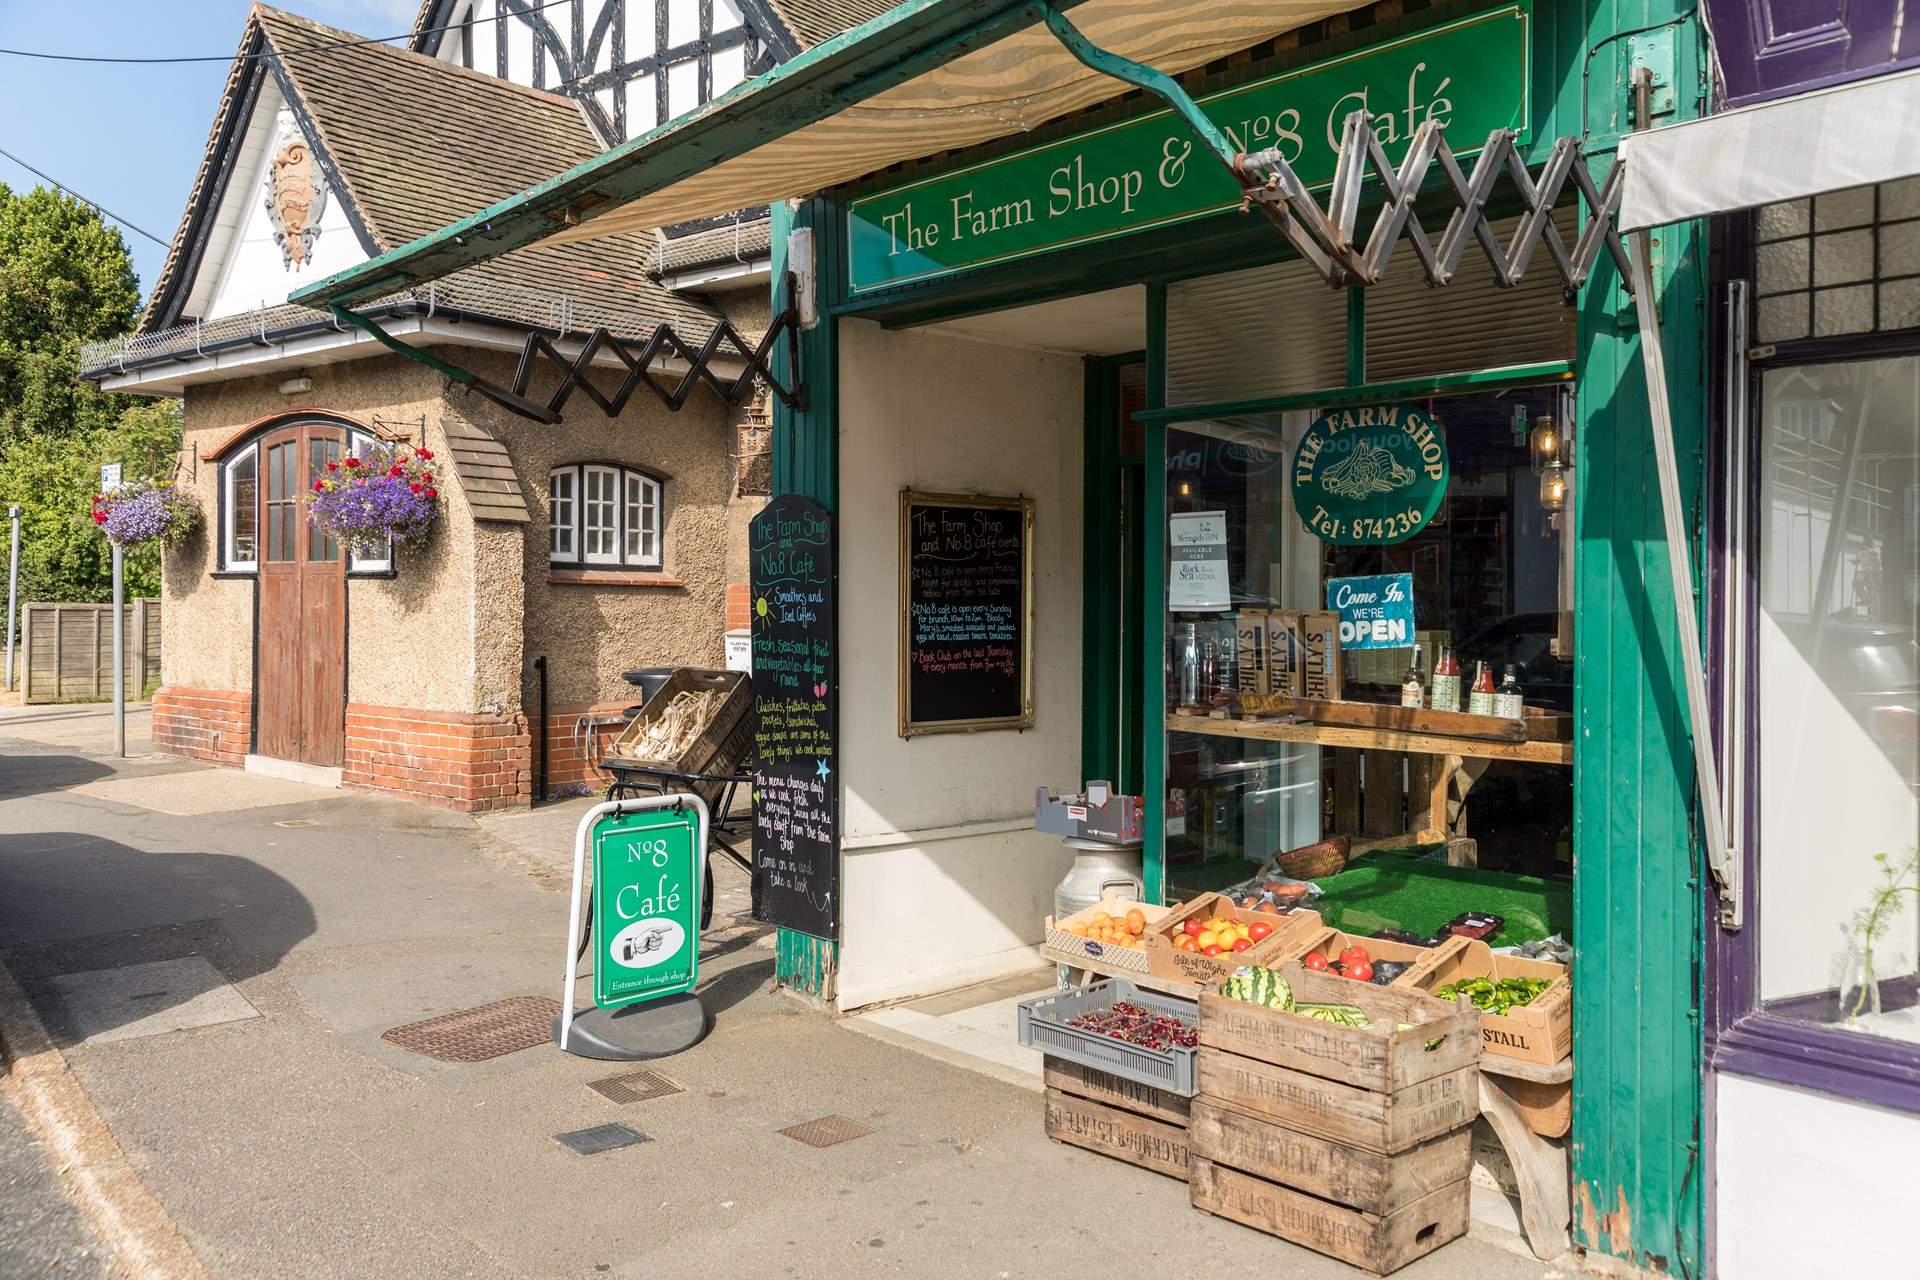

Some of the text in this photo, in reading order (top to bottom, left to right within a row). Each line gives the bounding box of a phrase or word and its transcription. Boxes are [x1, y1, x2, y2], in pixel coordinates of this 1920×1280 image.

[881, 210, 940, 257] The
[951, 191, 1035, 242] Farm
[1048, 155, 1144, 218] Shop
[1158, 136, 1192, 190] &
[1326, 62, 1453, 157] Café
[1296, 406, 1443, 487] THE FARM SHOP
[753, 508, 827, 541] The Farm Shop
[912, 509, 1003, 538] The Farm Shop
[1352, 506, 1422, 539] 874236
[779, 537, 792, 548] and
[921, 537, 941, 553] and
[975, 535, 996, 558] café
[998, 533, 1019, 548] events
[790, 551, 814, 583] Café
[775, 586, 824, 605] Smoothies and
[1336, 582, 1405, 609] Come In
[779, 604, 795, 624] Iced
[918, 615, 927, 625] for
[958, 605, 972, 617] open
[973, 605, 988, 616] every
[989, 603, 1012, 618] Sunday
[1352, 608, 1385, 619] WE'RE
[1339, 619, 1406, 642] OPEN
[812, 638, 830, 662] fruit
[919, 649, 936, 664] Book
[937, 649, 952, 661] Club
[953, 652, 961, 660] on
[962, 648, 972, 658] the
[986, 644, 1013, 660] Thursday
[767, 656, 802, 681] vegetables
[930, 664, 946, 674] every
[947, 661, 967, 671] month
[969, 660, 984, 671] from
[1307, 633, 1325, 699] CHILLY'S
[754, 770, 824, 803] The menu changes daily
[760, 789, 767, 799] as
[769, 789, 777, 799] we
[810, 809, 820, 821] all
[821, 811, 831, 824] the
[791, 820, 804, 838] from
[807, 825, 816, 839] the
[780, 835, 795, 855] Shop
[758, 849, 776, 868] Come
[779, 859, 787, 871] on
[789, 857, 796, 872] in
[770, 870, 810, 897] take a look
[616, 873, 681, 920] Café
[1199, 958, 1229, 977] Wight
[612, 970, 686, 991] Entrance through shop
[1483, 1029, 1530, 1050] STALL
